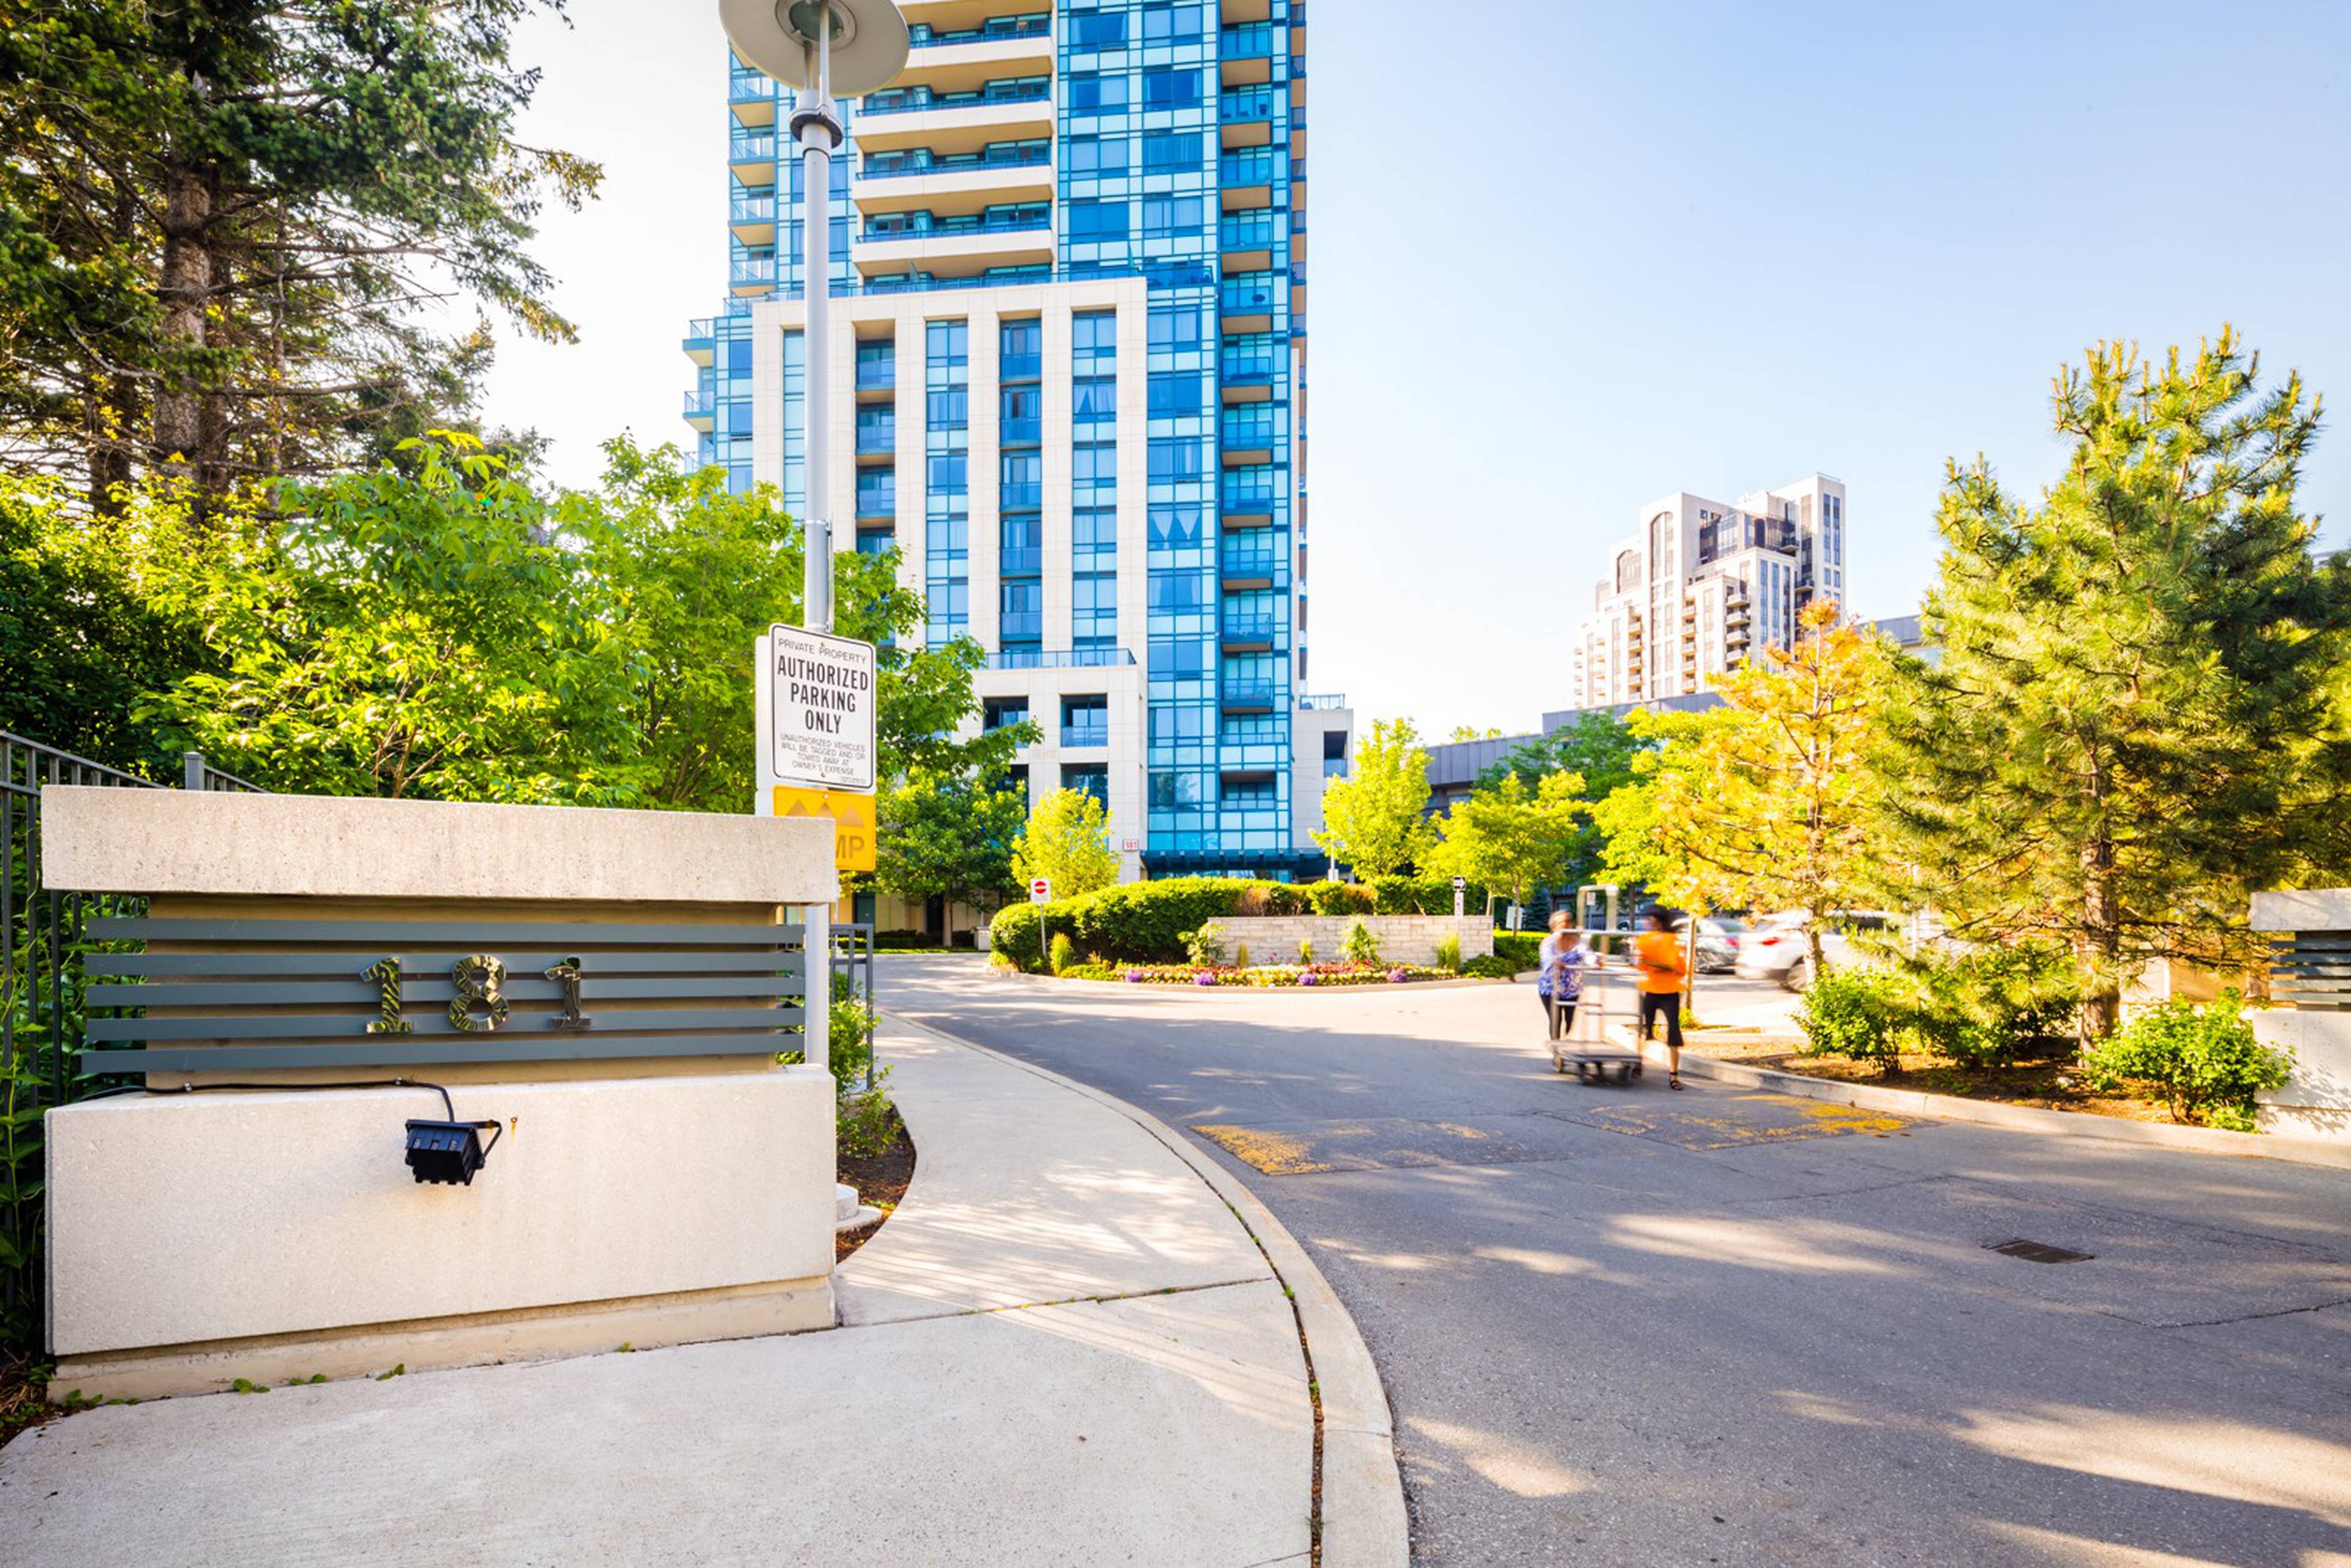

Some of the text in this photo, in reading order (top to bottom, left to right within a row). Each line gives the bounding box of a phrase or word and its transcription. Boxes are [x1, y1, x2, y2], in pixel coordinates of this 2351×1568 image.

[778, 638, 866, 664] PRIVATE PROPERTY
[778, 655, 868, 691] AUTHORIZED
[790, 682, 856, 713] PARKING
[805, 709, 841, 734] ONLY
[781, 733, 866, 752] UNAUTHORIZED VEHICLES
[781, 741, 797, 751] WILL
[799, 744, 808, 752] BE
[797, 751, 820, 763] TOWED
[825, 765, 855, 776] EXPENSE
[359, 954, 591, 1034] 181
